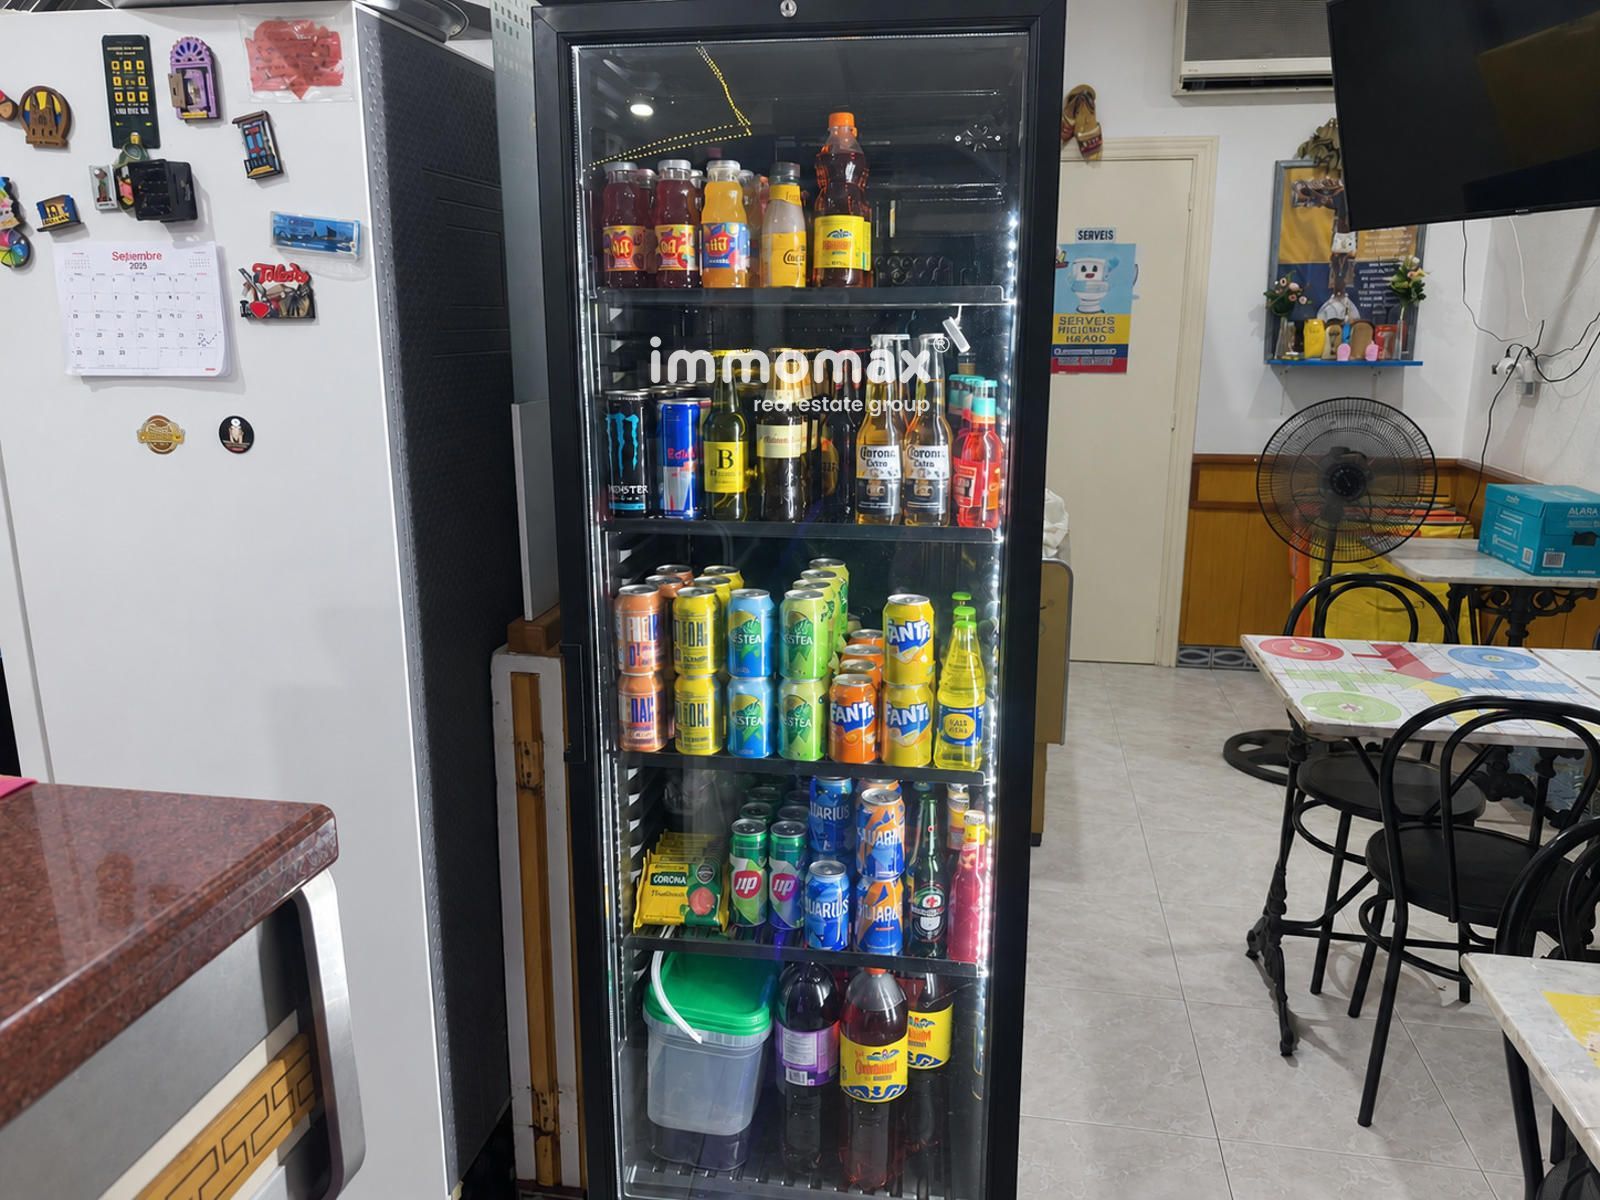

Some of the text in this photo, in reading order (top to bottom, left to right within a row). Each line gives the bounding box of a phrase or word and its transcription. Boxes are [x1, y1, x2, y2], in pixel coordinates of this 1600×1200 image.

[1077, 229, 1114, 241] SERVEIS
[715, 448, 735, 470] B
[652, 873, 687, 885] CORONA
